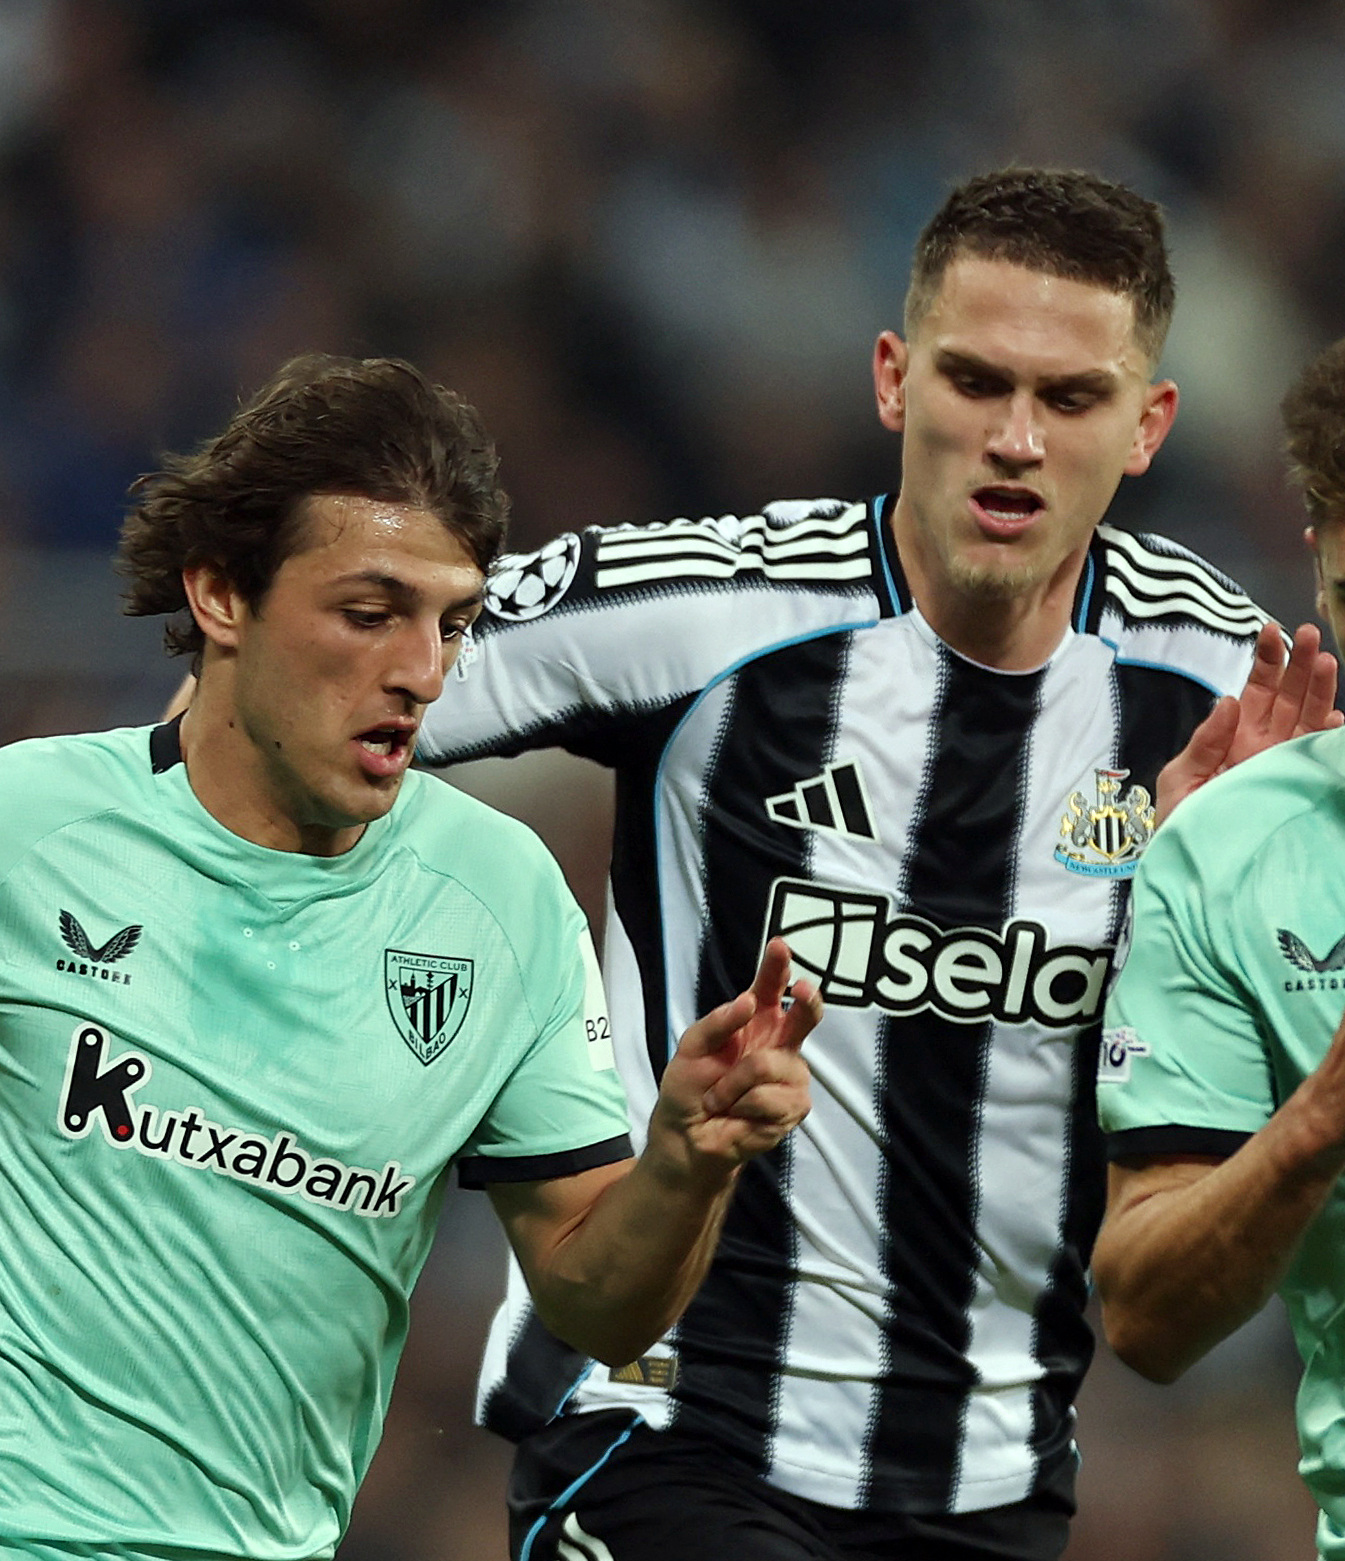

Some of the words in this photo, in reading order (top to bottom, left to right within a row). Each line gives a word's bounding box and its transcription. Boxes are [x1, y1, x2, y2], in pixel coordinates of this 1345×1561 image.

[390, 955, 438, 969] ATHLETIC
[439, 961, 468, 972] CLUB
[875, 929, 1109, 1019] sela
[408, 1029, 446, 1060] BILBAO
[64, 1028, 409, 1213] Kutxabank
